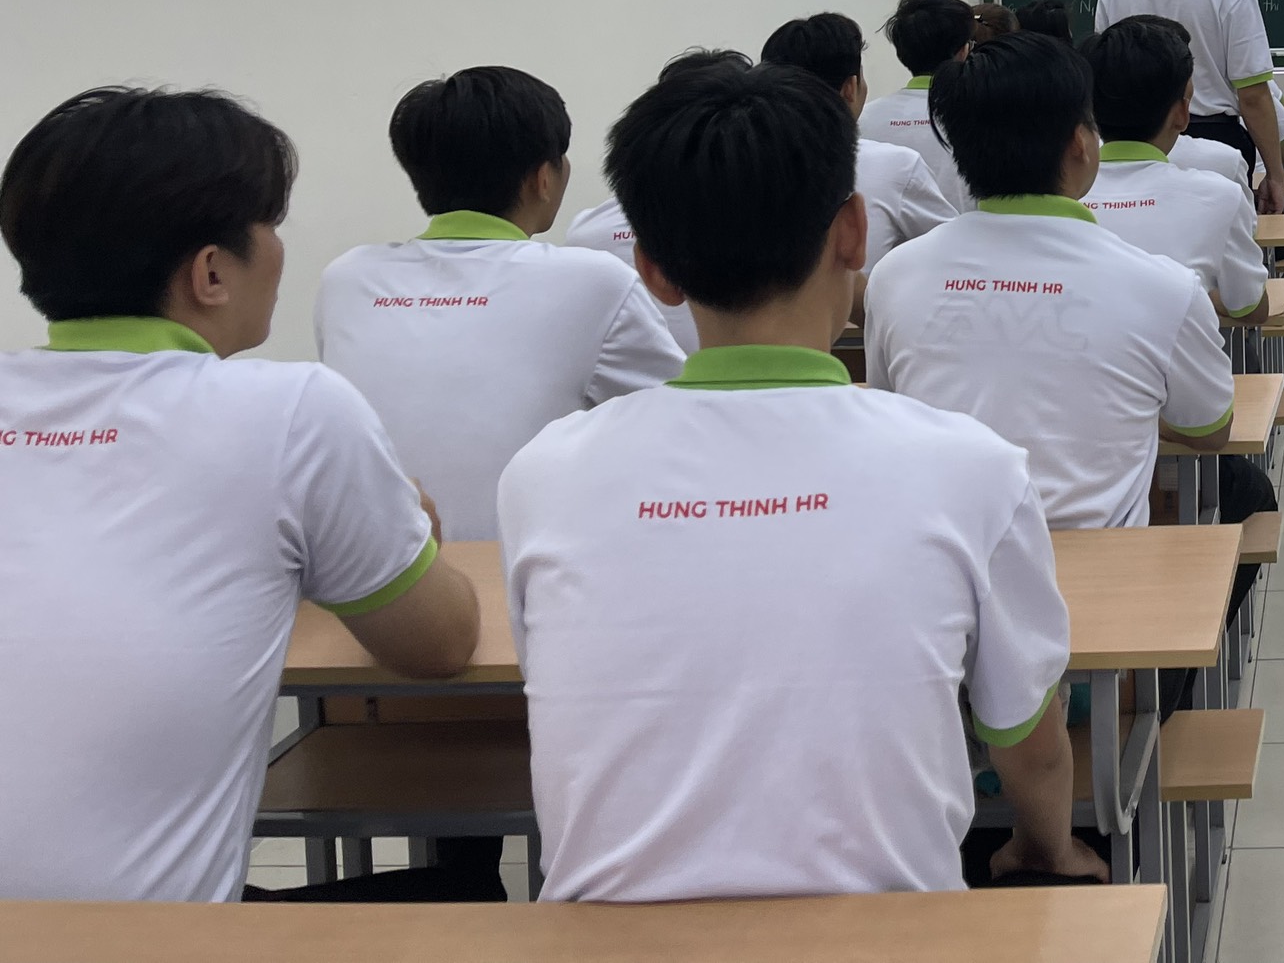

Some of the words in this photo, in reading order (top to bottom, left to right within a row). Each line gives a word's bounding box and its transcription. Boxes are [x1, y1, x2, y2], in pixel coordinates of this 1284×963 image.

[1102, 201, 1136, 209] THINH
[1140, 199, 1155, 207] HR
[944, 279, 987, 291] HUNG
[992, 280, 1037, 293] THINH
[1042, 283, 1063, 294] HR
[373, 297, 414, 307] HUNG
[418, 297, 462, 307] THINH
[466, 297, 488, 306] HR
[24, 430, 85, 446] THINH
[89, 429, 118, 445] HR
[638, 501, 707, 519] HUNG
[715, 496, 787, 518] THINH
[796, 493, 829, 513] HR
